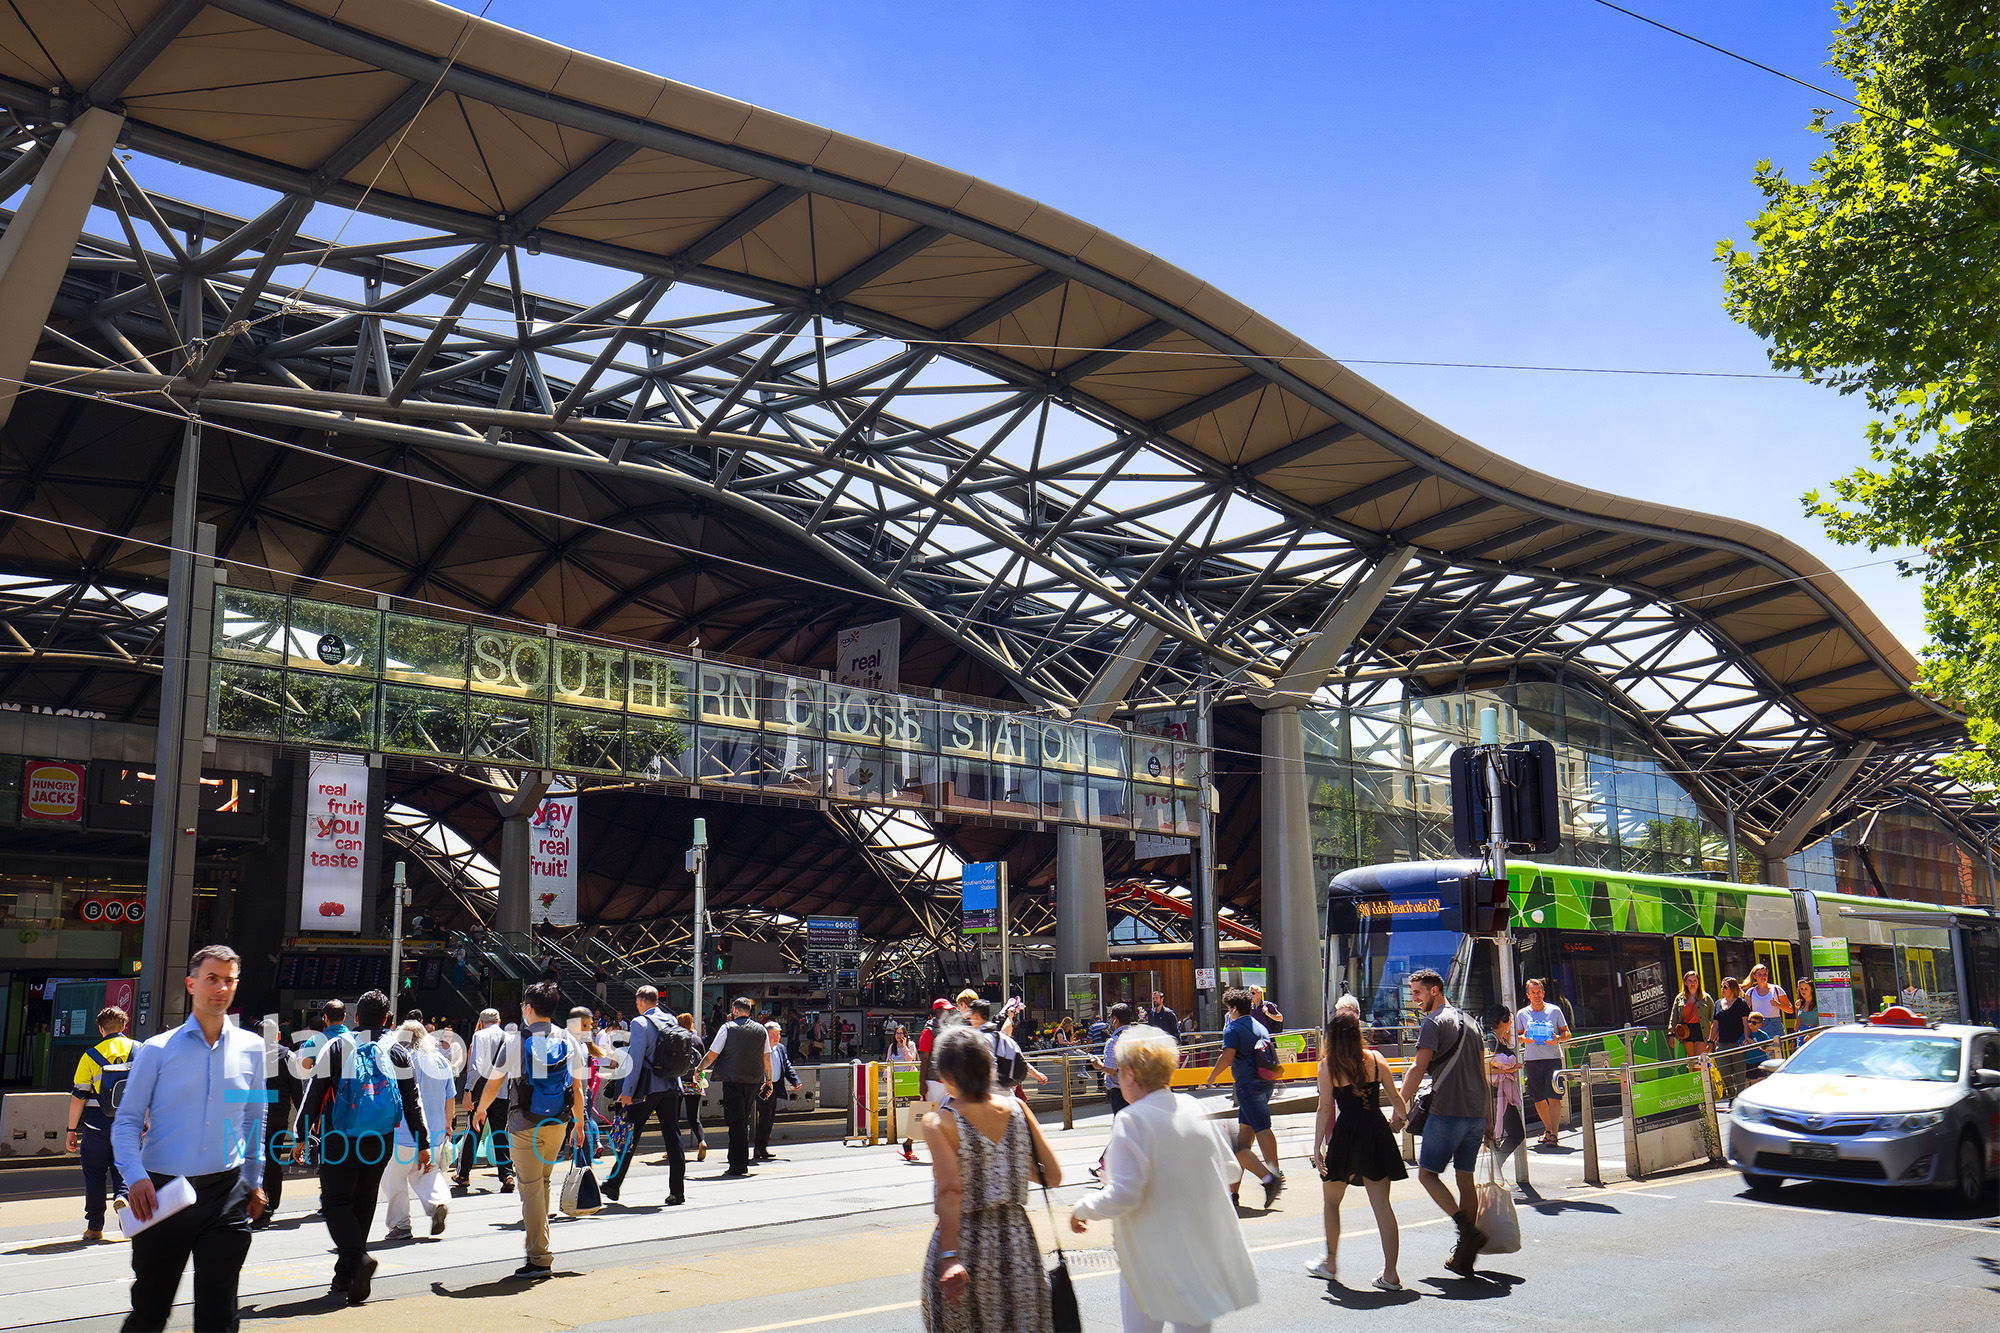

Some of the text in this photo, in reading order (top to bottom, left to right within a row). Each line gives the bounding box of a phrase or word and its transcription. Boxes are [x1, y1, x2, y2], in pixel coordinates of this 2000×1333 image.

[852, 648, 881, 672] real
[472, 635, 757, 722] SOUTHERN
[786, 687, 922, 743] CROSS
[952, 712, 1085, 766] STATION
[32, 780, 77, 791] HUNGRY
[318, 783, 347, 797] real
[31, 790, 76, 805] JACK'S
[327, 798, 365, 816] fruit
[533, 801, 574, 829] yay
[317, 815, 360, 838] you
[549, 825, 565, 839] for
[335, 838, 363, 851] can
[539, 837, 570, 857] real
[310, 851, 359, 869] taste
[1630, 983, 1665, 1005] MELBOURNE
[1659, 1092, 1704, 1109] Southern Cross Station
